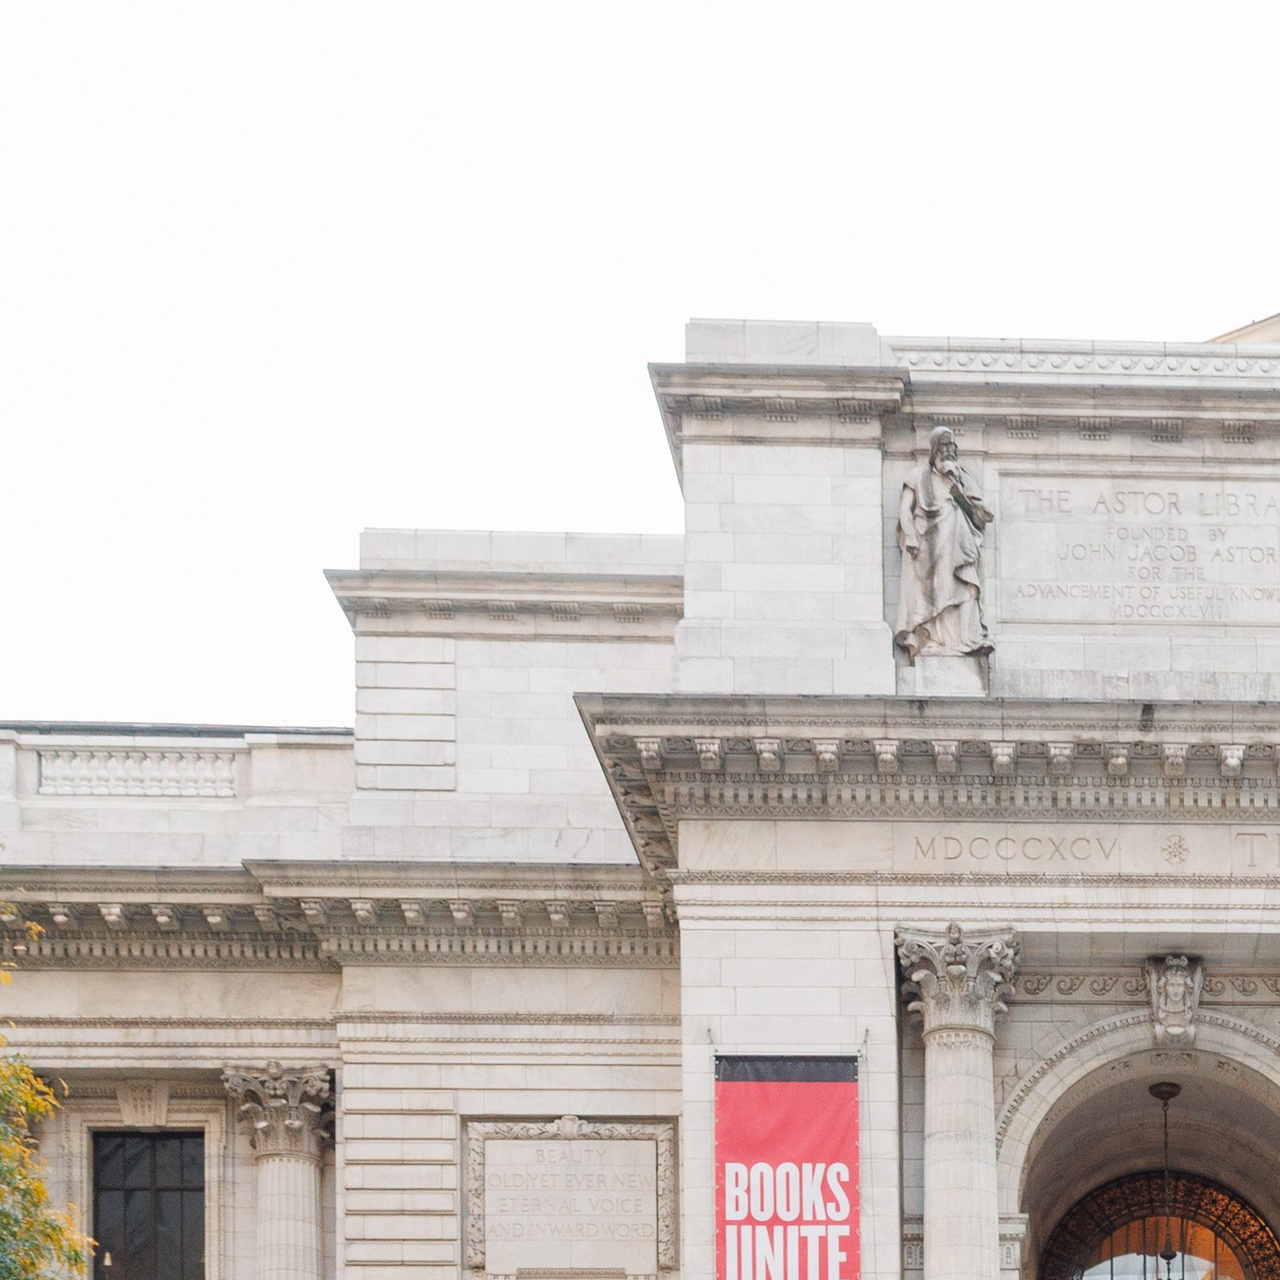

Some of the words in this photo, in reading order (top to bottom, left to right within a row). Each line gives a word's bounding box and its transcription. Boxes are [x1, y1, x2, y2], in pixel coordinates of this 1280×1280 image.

[1018, 489, 1071, 514] THE
[1092, 490, 1183, 516] ASTOR
[1106, 526, 1189, 541] FOUNDED
[1208, 527, 1228, 542] BY
[1056, 543, 1116, 561] JOHN
[1127, 544, 1198, 563] JACOB
[1210, 545, 1278, 564] ASTOR
[1128, 565, 1161, 580] FOR
[1172, 566, 1206, 581] THE
[1014, 584, 1135, 600] ADVANCEMENT
[1140, 585, 1161, 600] OF
[1168, 586, 1225, 601] USEFUL
[914, 835, 1118, 862] MDCCCXCV
[536, 1148, 607, 1164] BEAUTY
[487, 1173, 525, 1188] OLD
[527, 1173, 560, 1188] YET
[565, 1173, 608, 1188] EVER
[614, 1173, 654, 1188] NEW
[724, 1162, 849, 1222] BOOKS
[499, 1197, 582, 1213] ETERNAL
[588, 1198, 643, 1213] VOICE
[487, 1222, 525, 1238] AND
[529, 1222, 599, 1238] INWARD
[601, 1222, 655, 1238] WORD
